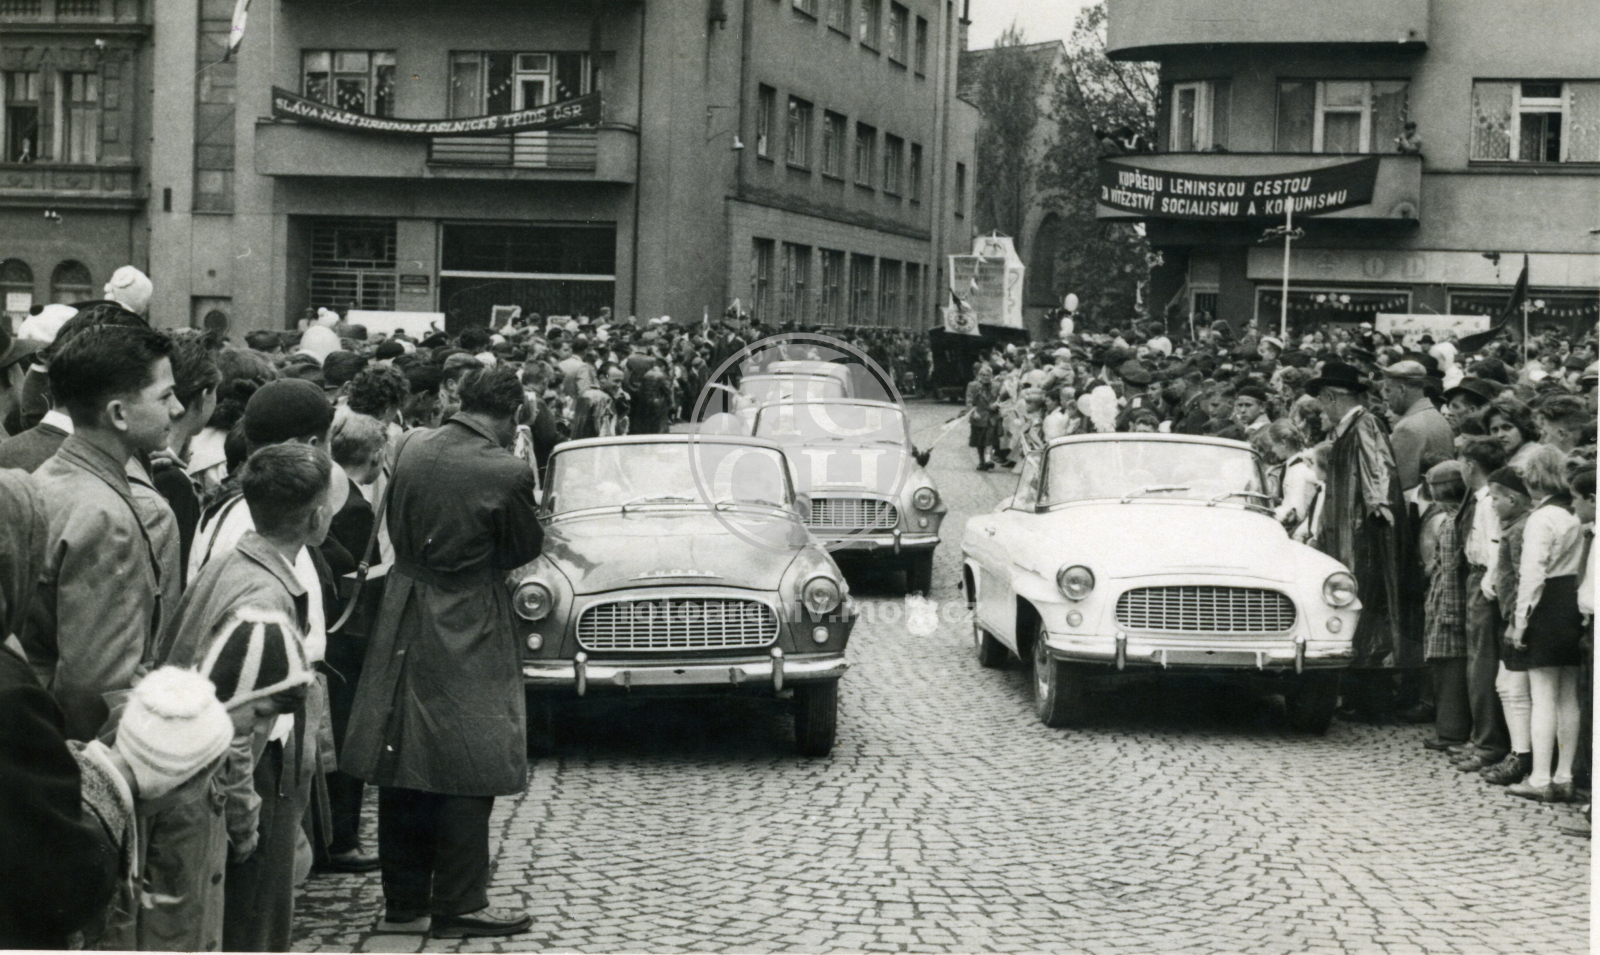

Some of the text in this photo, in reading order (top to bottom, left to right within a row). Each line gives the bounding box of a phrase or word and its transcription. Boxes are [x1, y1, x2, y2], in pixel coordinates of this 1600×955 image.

[1118, 169, 1312, 197] KUPŘEDU LENINSKOU CESTOU
[1161, 197, 1239, 217] SOCIALISMU
[1247, 201, 1257, 215] A
